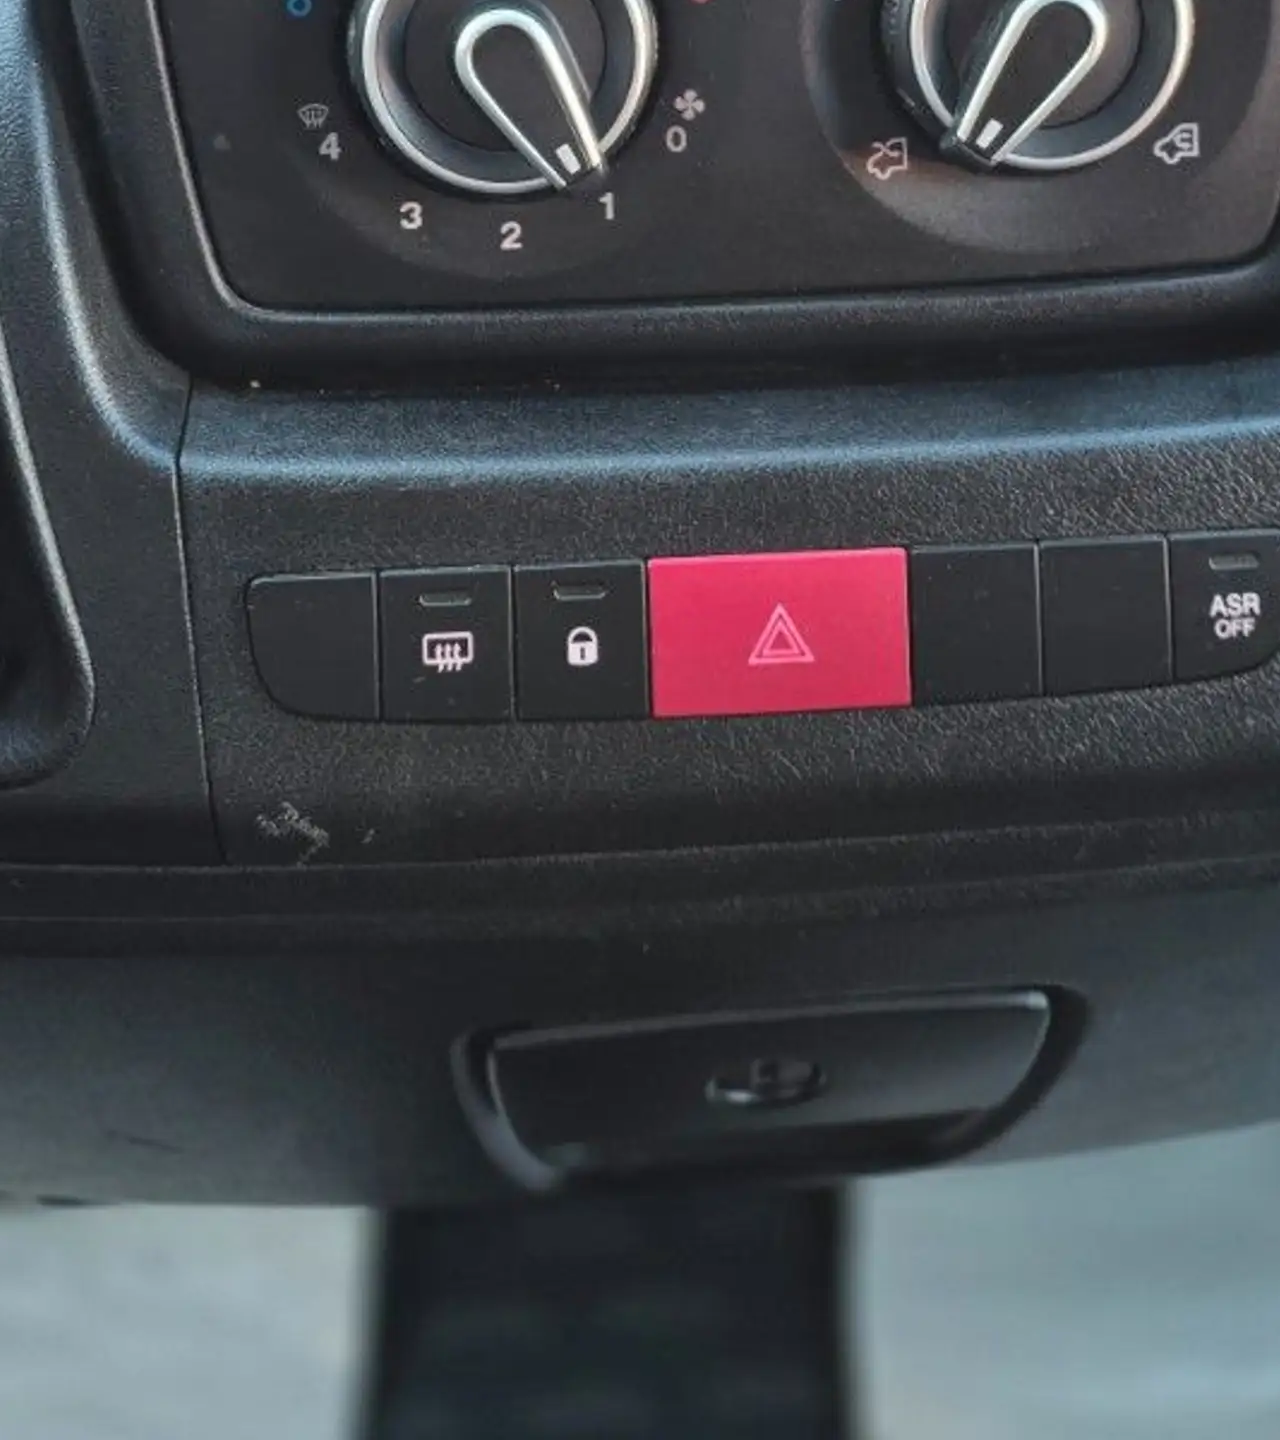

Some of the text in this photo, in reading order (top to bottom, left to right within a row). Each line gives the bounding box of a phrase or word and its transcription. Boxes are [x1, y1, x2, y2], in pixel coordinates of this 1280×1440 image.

[318, 131, 343, 161] 4
[665, 125, 688, 153] 0
[399, 201, 423, 230] 3
[598, 192, 616, 221] 1
[499, 221, 523, 250] 2
[1209, 592, 1261, 618] ASR
[1213, 617, 1256, 640] OFF
